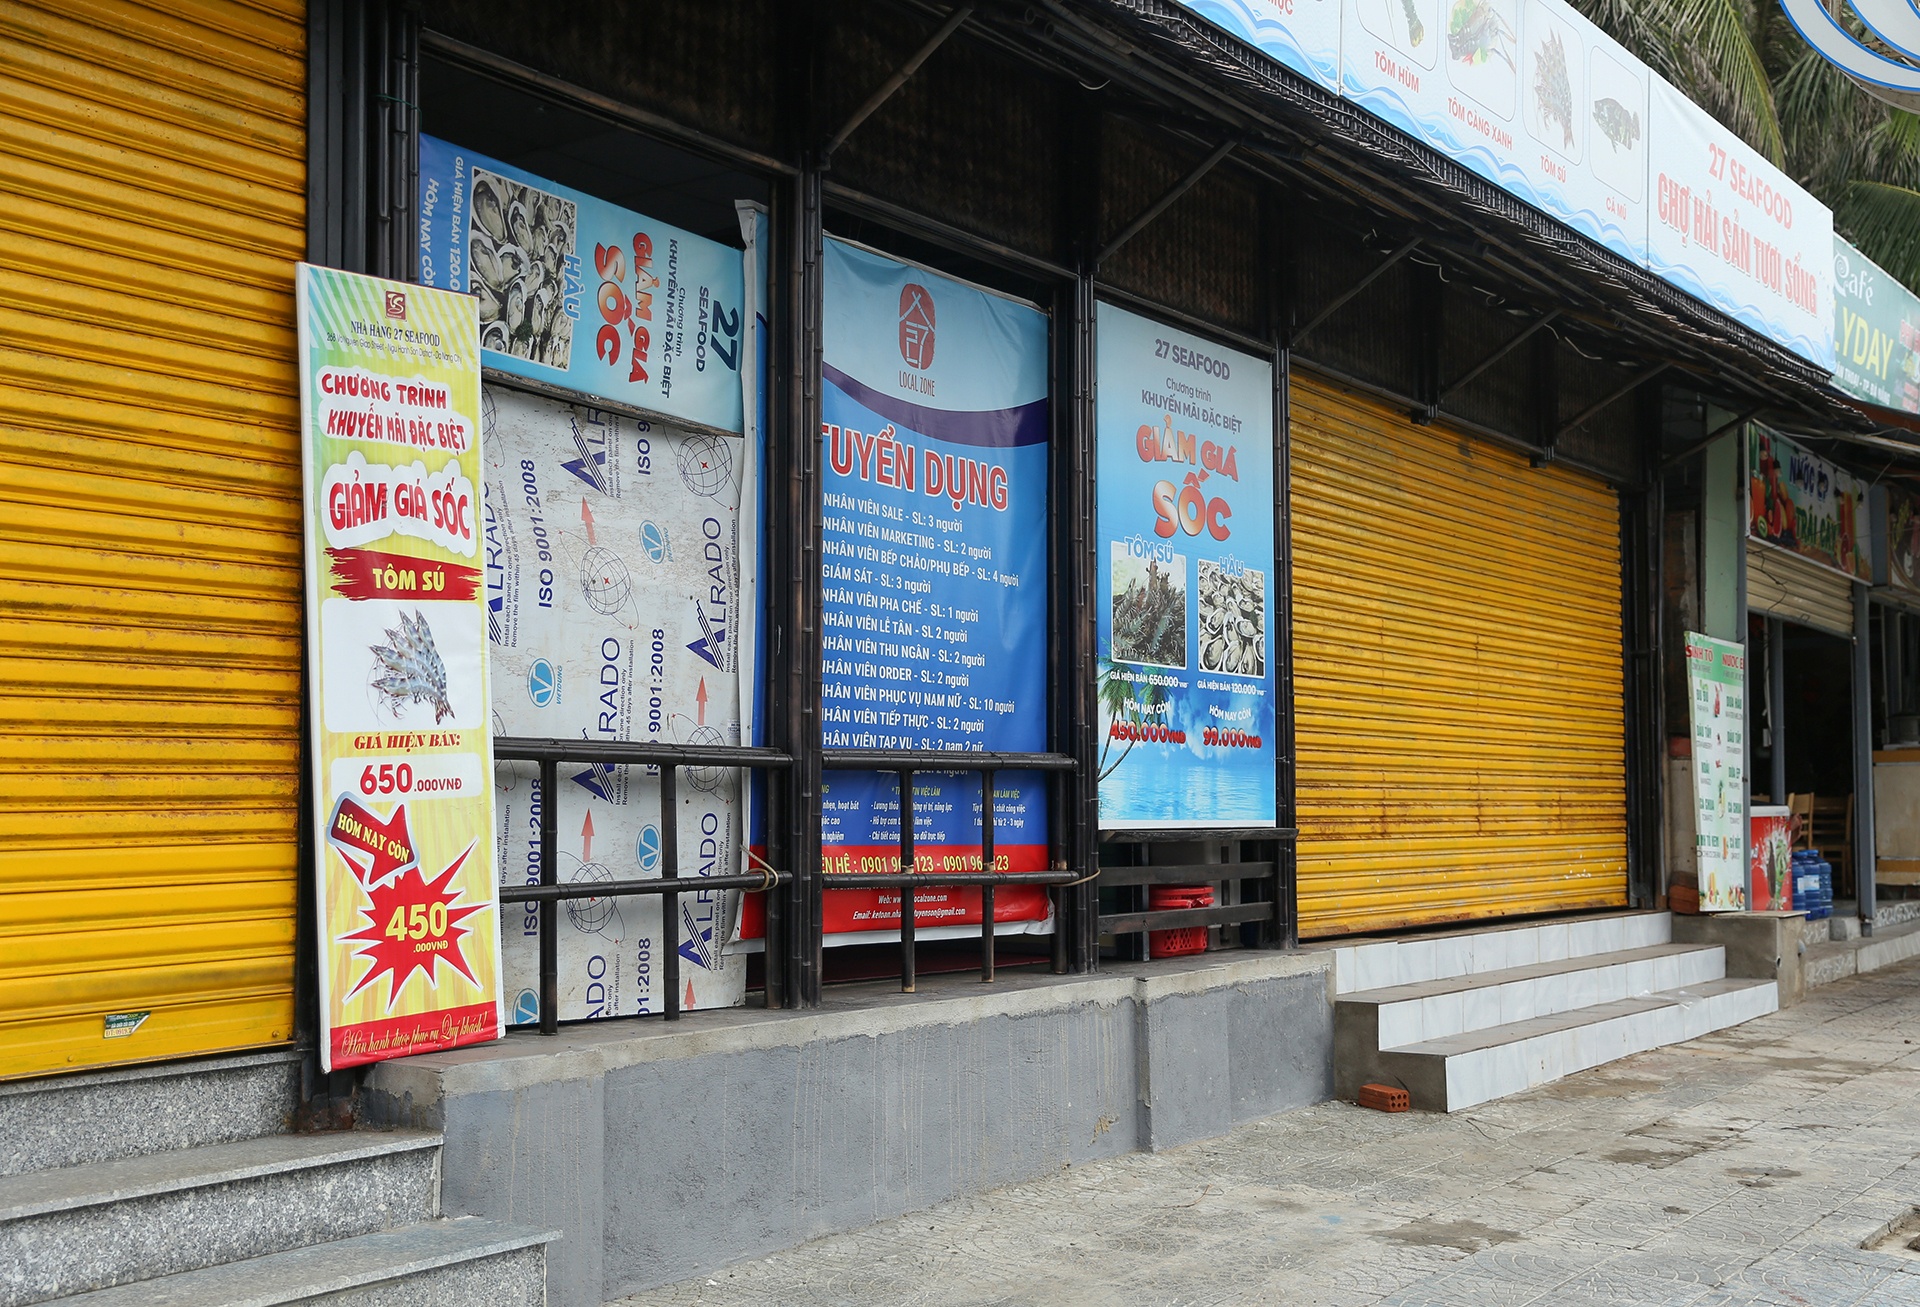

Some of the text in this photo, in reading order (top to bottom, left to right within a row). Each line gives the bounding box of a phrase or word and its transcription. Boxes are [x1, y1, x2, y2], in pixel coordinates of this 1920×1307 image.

[1375, 51, 1420, 93] TÔM HÙM
[1448, 97, 1513, 150] TÔM CÀNG XANH
[1541, 155, 1567, 183] TÔM SÚ
[1708, 142, 1793, 230] 27 SEAFOOD
[420, 178, 440, 253] HÔM NAY
[451, 156, 465, 244] GIÁ HIỆN BÁN
[1606, 197, 1616, 214] CÁ
[1657, 172, 1817, 318] CHỢ HẢI SẢN TƯƠI SỐNG
[563, 253, 585, 320] HÀU
[1833, 250, 1874, 306] Café
[594, 242, 636, 366] SỐC
[629, 232, 660, 384] GIẢM GIÁ
[660, 239, 678, 398] KHUYẾN MÃI ĐẶC BIỆT
[676, 287, 686, 357] Chương trình
[351, 318, 440, 347] NHÀ HÀNG 27 SEAFOOD
[696, 285, 709, 372] SEAFOOD
[711, 300, 739, 371] 27
[1155, 338, 1230, 381] 27 SEAFOOD
[321, 373, 447, 409] CHƯƠNG TRÌNH
[899, 370, 935, 397] LOCAL ZONE
[1166, 377, 1212, 403] Chương trình
[327, 402, 466, 455] KHUYẾN MÃI ĐẶC BIỆT
[1141, 389, 1242, 435] KHUYẾN MÃI ĐẶC BIỆT
[1136, 414, 1239, 482] GIẢM GIÁ
[924, 449, 1008, 512] DỤNG
[329, 469, 470, 540] GIẢM GIÁ SỐC
[823, 492, 963, 534] NHÂN VIÊN SALE SL: người
[1152, 469, 1232, 542] SỐC
[1796, 505, 1817, 545] TRÁI
[520, 460, 553, 608] ISO 9001:2008
[823, 516, 992, 560] NHÂN VIÊN MARKETING SL: người
[1124, 534, 1174, 564] TÔM SÚ
[373, 563, 445, 591] TÔM SÚ
[822, 539, 1019, 588] NHÂN VIÊN BẾP CHẢO/PHỤ BẾP SL: người
[822, 563, 931, 595] GIÁM SÁT SL: người
[1219, 553, 1244, 577] HÀU
[505, 582, 514, 603] panel
[880, 598, 922, 615] PHA CHẾ
[503, 624, 511, 647] Install
[511, 618, 519, 648] Remove
[879, 642, 930, 660] THU NGÂN
[648, 628, 664, 733] 9001:2008
[879, 666, 912, 681] ORDER
[1110, 670, 1148, 683] GIÁ HIỆN BÁN
[879, 688, 907, 707] PHỤC
[1123, 697, 1171, 715] HÔM NAY CÒN
[880, 708, 929, 732] TIẾP THỰC
[354, 731, 461, 753] GIÁ HIỆN BÁN:
[337, 813, 410, 863] HÔM NAY CÒN
[861, 856, 887, 874] 0901
[943, 855, 968, 872] 0901
[385, 901, 448, 941] 450
[853, 910, 872, 920] Email:
[413, 940, 448, 953] .000VNĐ
